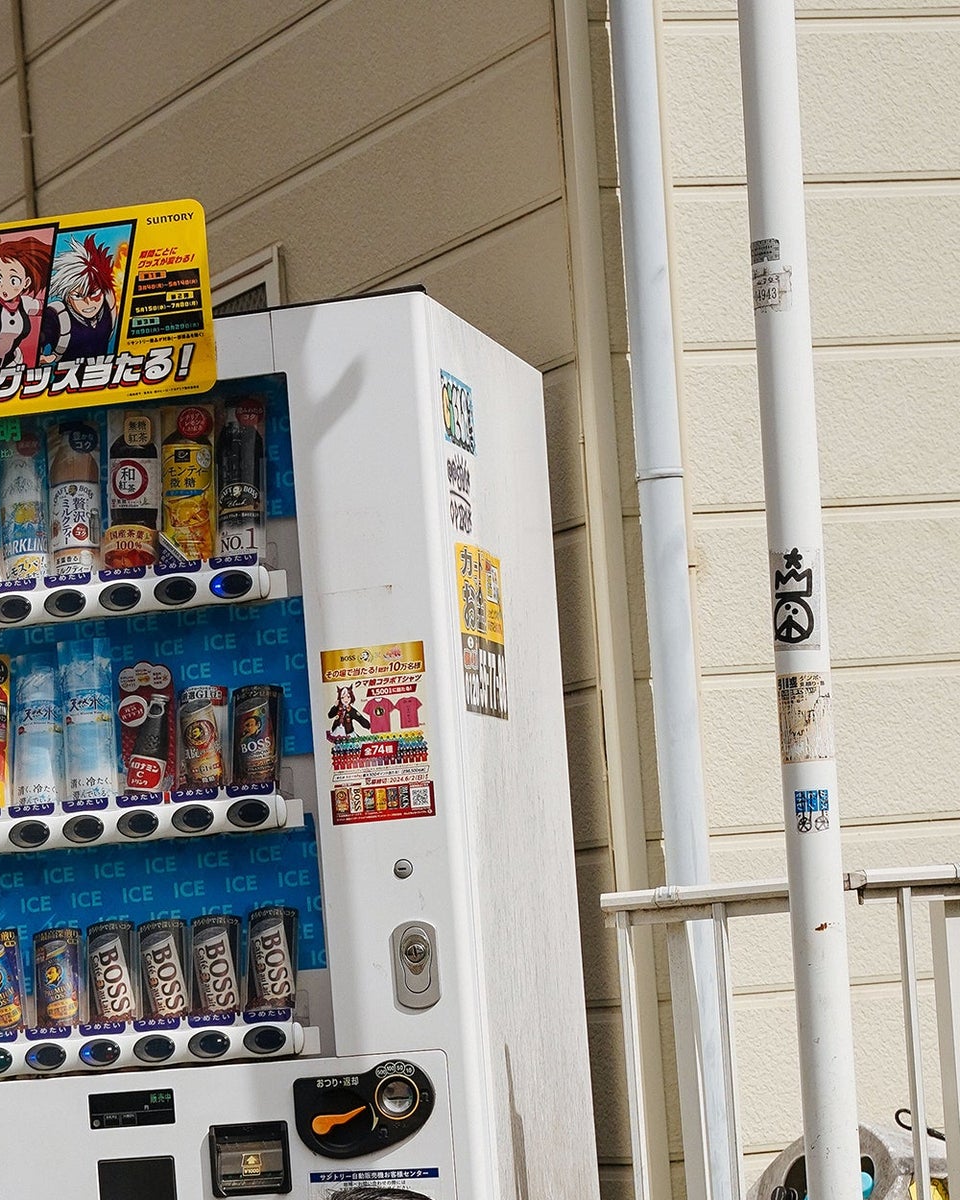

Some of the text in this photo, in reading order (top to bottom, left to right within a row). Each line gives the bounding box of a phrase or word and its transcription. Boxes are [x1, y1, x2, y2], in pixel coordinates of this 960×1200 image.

[146, 212, 194, 225] SUNTORY
[128, 432, 147, 444] 紅茶
[120, 467, 136, 481] 和
[119, 481, 136, 494] 紅茶
[170, 477, 196, 489] 微糖
[72, 498, 87, 523] 贅沢
[61, 499, 72, 545] ミルクティー
[115, 541, 142, 551] 100%
[220, 527, 258, 553] NO.1
[215, 554, 253, 564] つめたい
[104, 567, 141, 577] つめたい
[25, 628, 56, 643] ICE
[204, 634, 236, 650] ICE
[257, 629, 288, 645] ICE
[181, 663, 211, 680] ICE
[233, 658, 264, 675] ICE
[69, 695, 104, 712] 天然水
[23, 705, 58, 722] 天然水
[240, 736, 272, 753] BOSS
[231, 782, 269, 792] つめたい
[121, 792, 158, 802] つめたい
[353, 788, 361, 812] BOSS
[197, 851, 229, 868] ICE
[95, 861, 126, 878] ICE
[226, 875, 258, 892] ICE
[123, 886, 154, 902] ICE
[261, 930, 291, 997] BOSS
[98, 945, 131, 1013] BOSS
[151, 943, 185, 1011] BOSS
[204, 939, 236, 1008] BOSS
[139, 1016, 175, 1027] つめたい
[194, 1012, 231, 1022] つめたい
[316, 1076, 359, 1088] おつり・返却
[320, 1170, 429, 1181] サントリー自動販売機お客様センター
